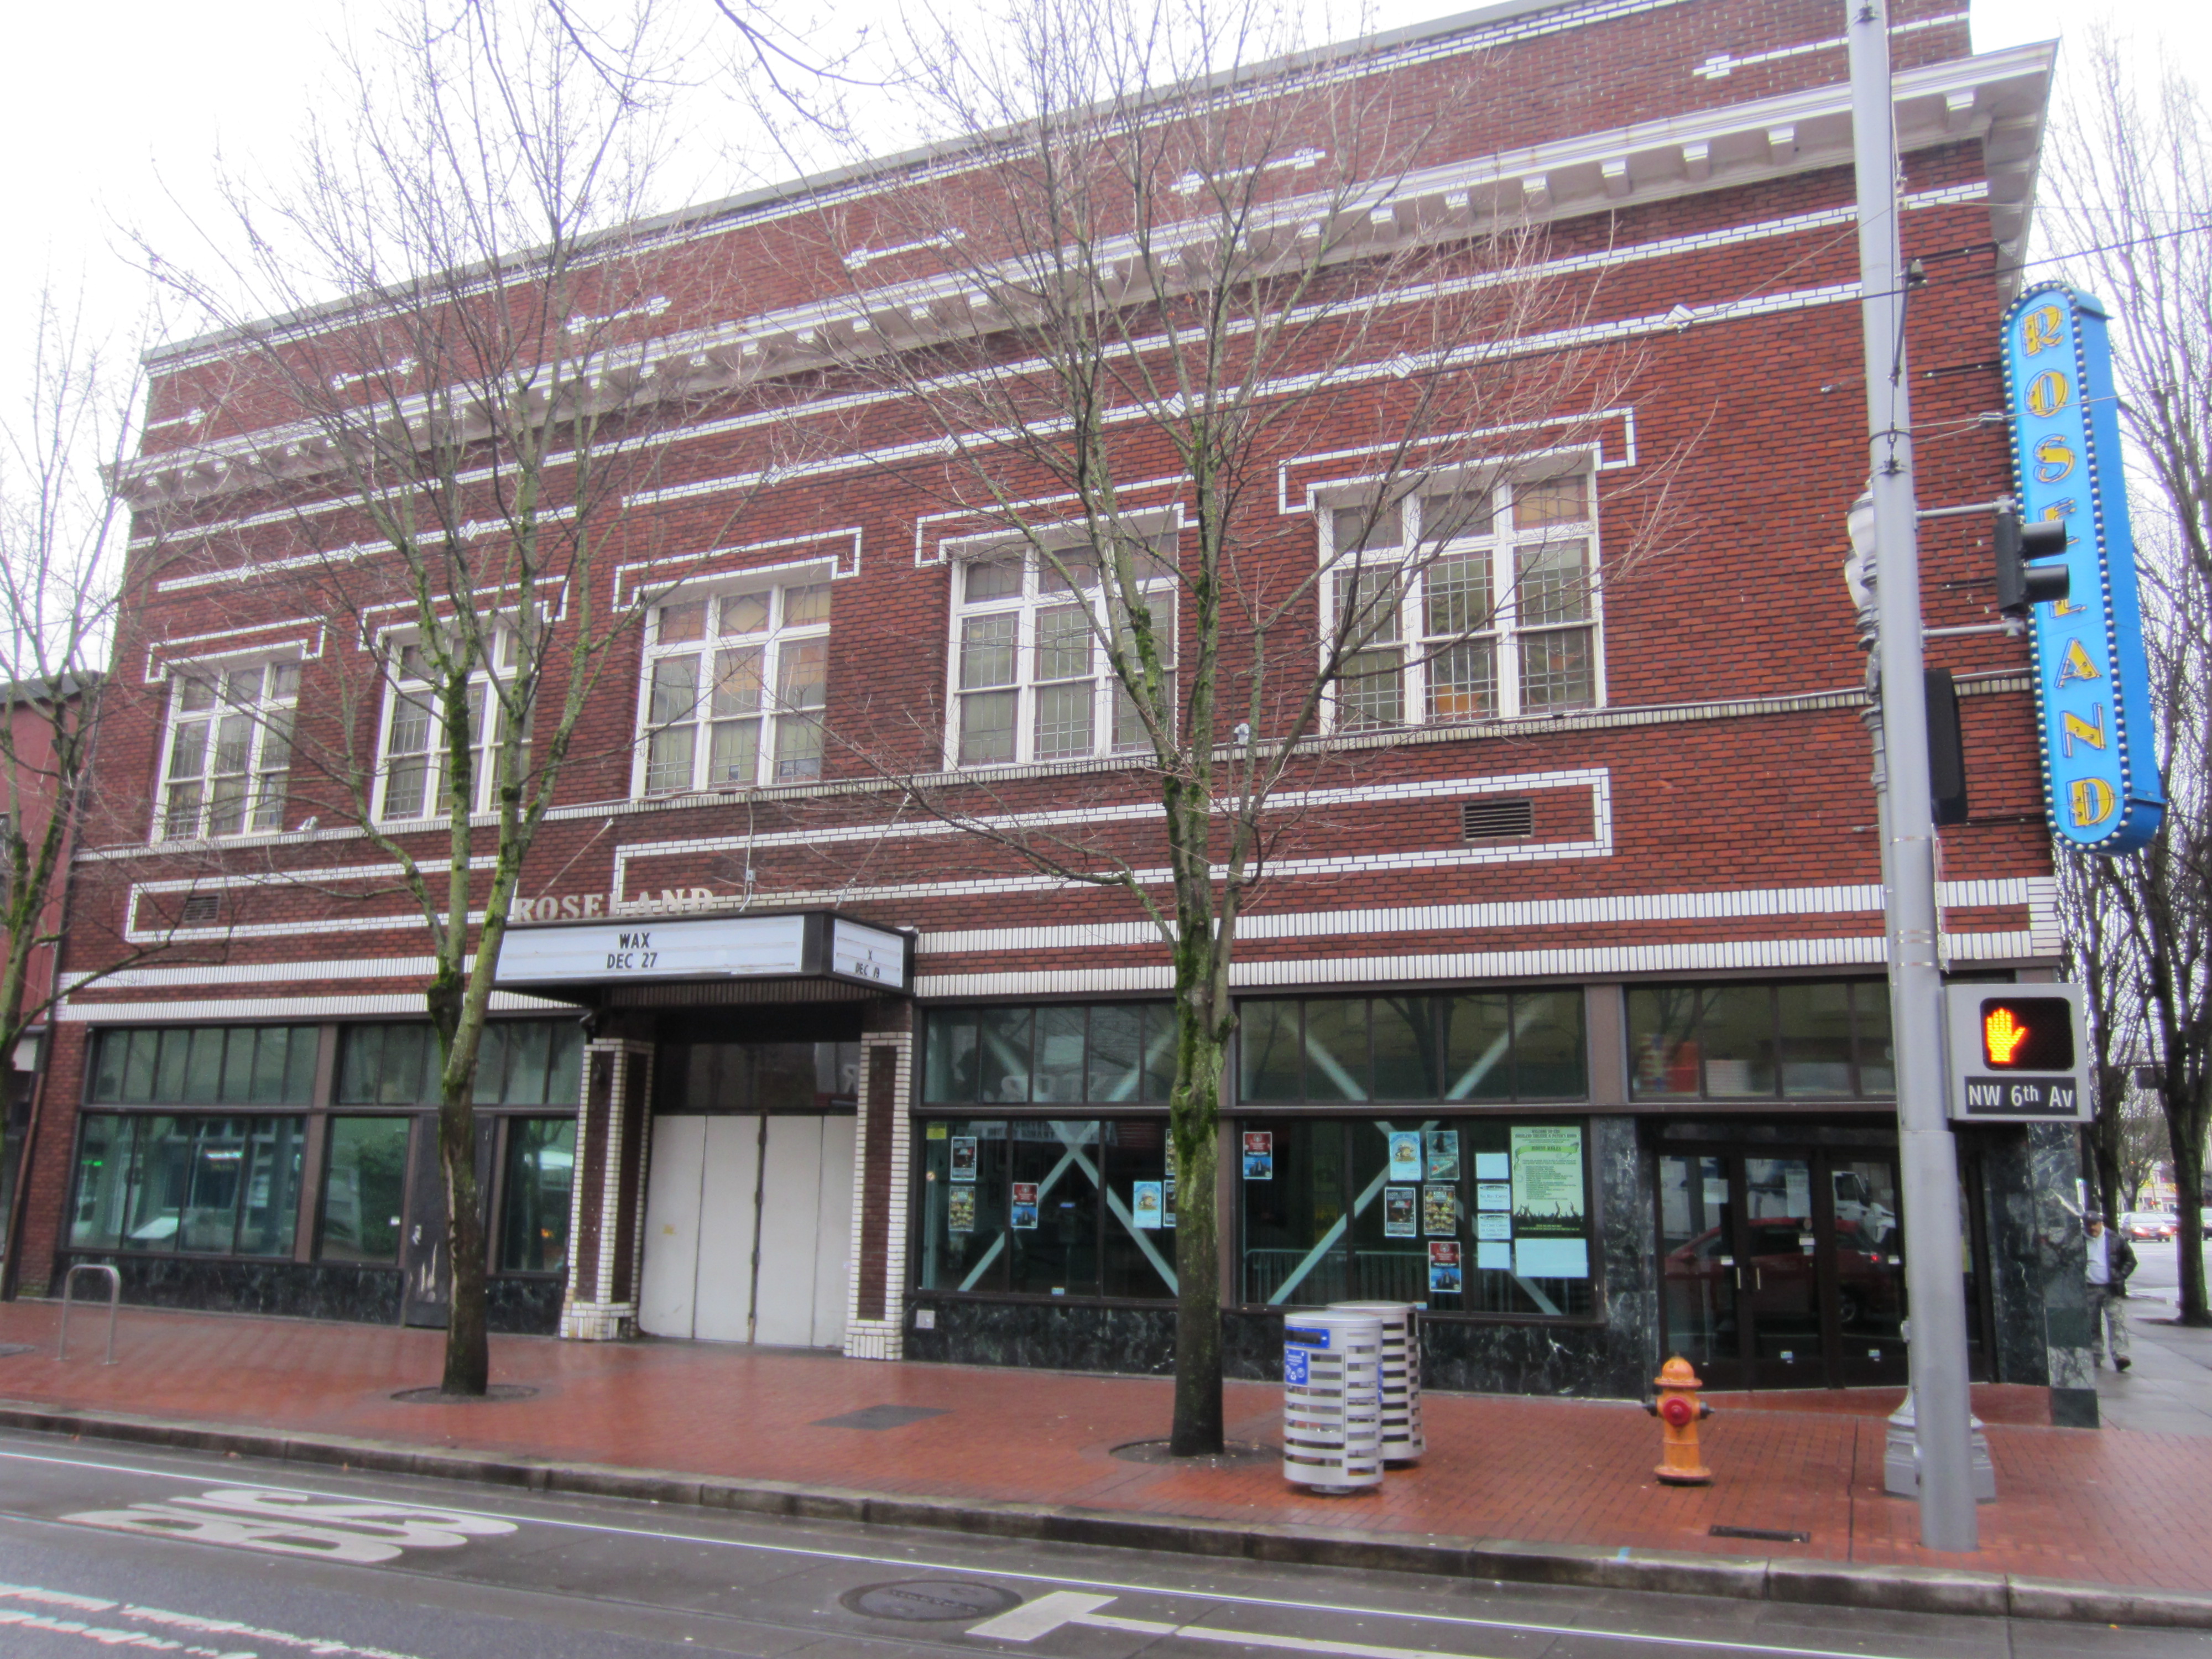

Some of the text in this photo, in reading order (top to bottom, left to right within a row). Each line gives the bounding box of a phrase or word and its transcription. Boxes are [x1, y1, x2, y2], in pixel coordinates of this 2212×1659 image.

[514, 888, 714, 923] ROSELAND
[619, 932, 651, 949] WAX
[607, 952, 659, 969] DEC 27
[855, 962, 869, 975] DEC
[1968, 1084, 2074, 1108] NW 6th Av
[57, 1489, 519, 1563] BUS
